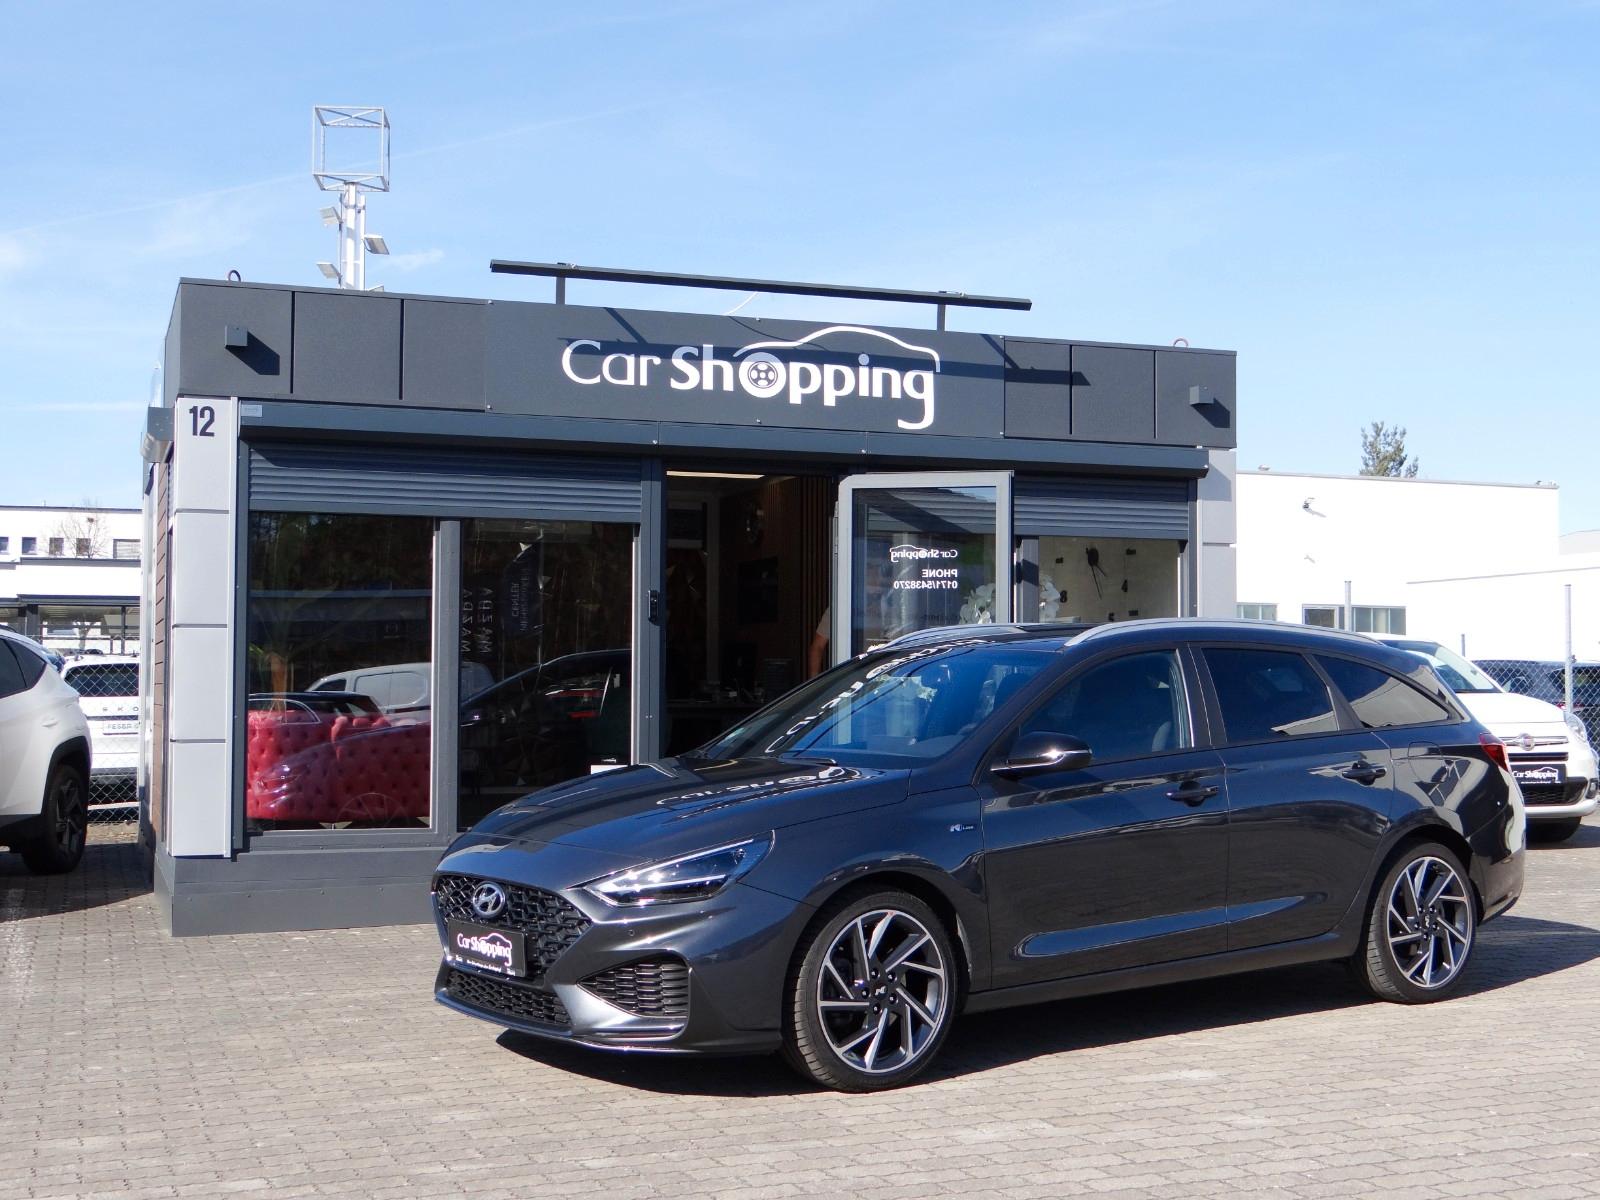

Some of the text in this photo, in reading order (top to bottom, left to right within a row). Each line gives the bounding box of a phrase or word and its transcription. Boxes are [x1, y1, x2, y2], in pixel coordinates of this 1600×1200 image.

[561, 339, 936, 430] Car Shopping
[188, 405, 216, 438] 12
[457, 933, 470, 948] Car
[470, 935, 513, 967] Shopping
